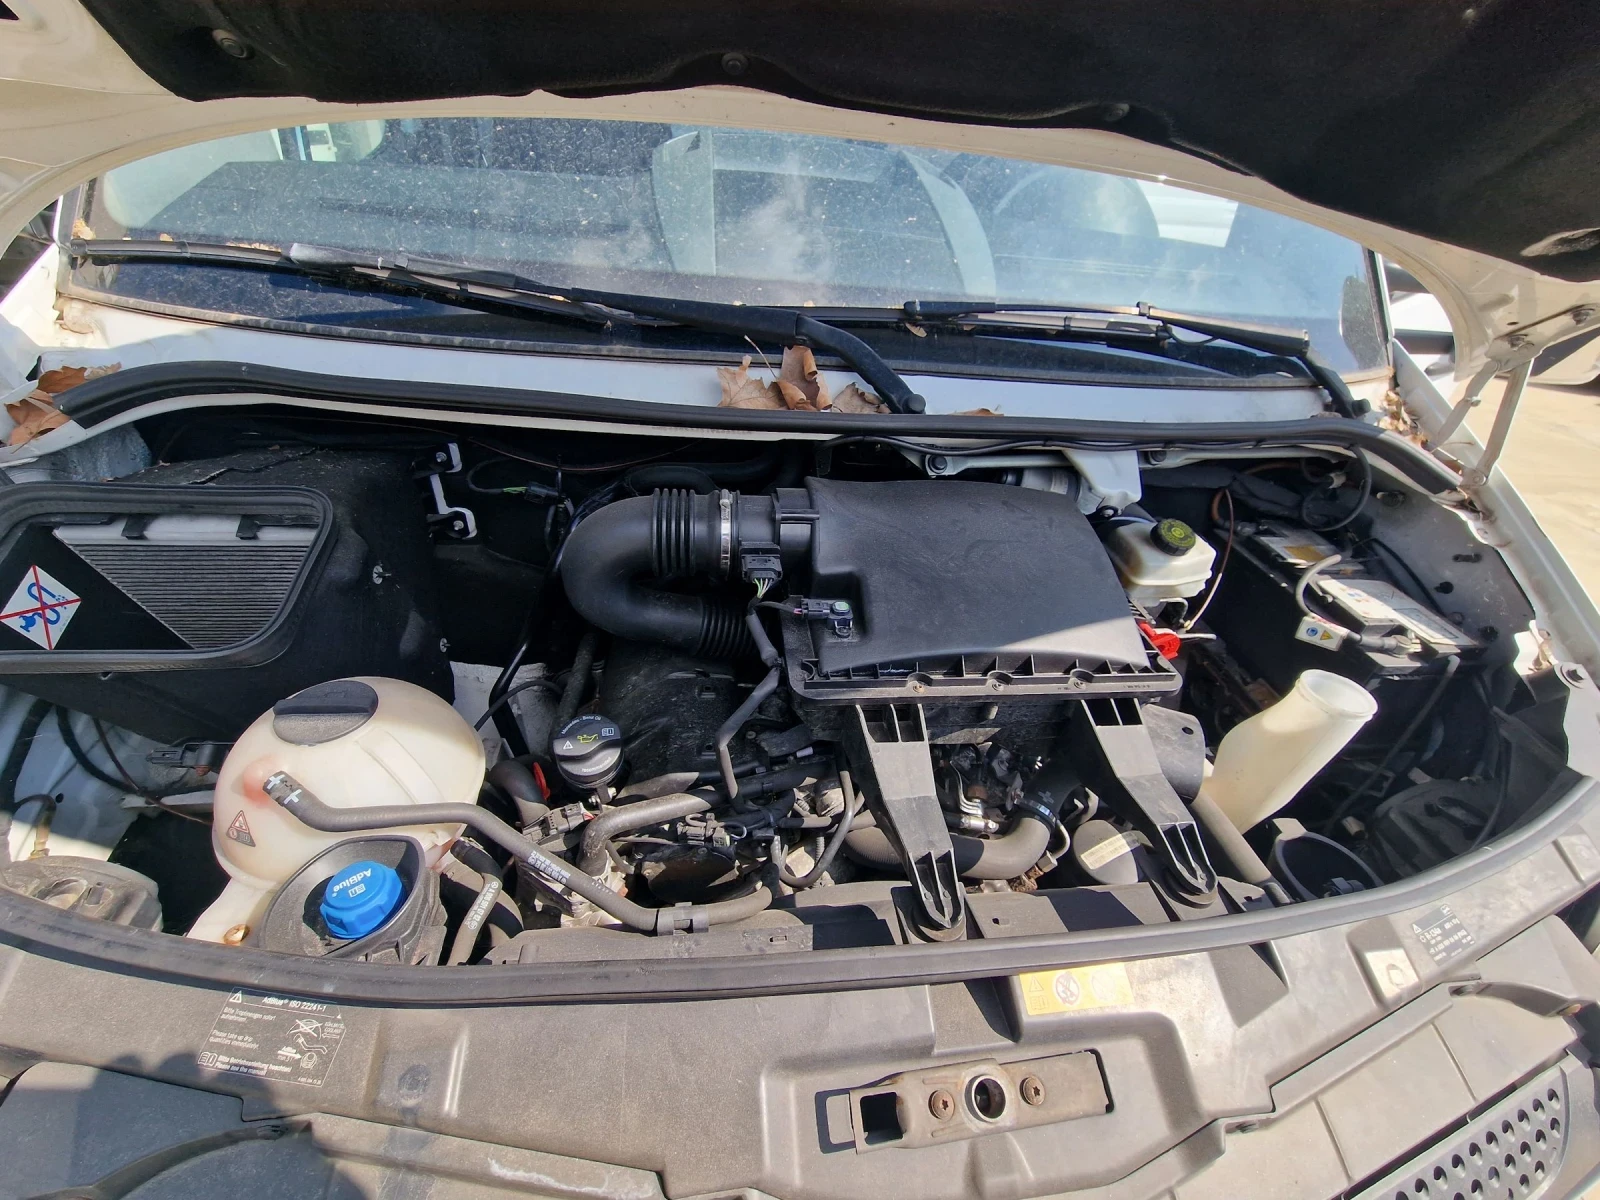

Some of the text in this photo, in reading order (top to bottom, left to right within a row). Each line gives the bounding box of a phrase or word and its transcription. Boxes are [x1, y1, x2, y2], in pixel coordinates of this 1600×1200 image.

[332, 867, 372, 892] AdBlue
[289, 1000, 301, 1008] ISO
[300, 1001, 327, 1012] 22241-1
